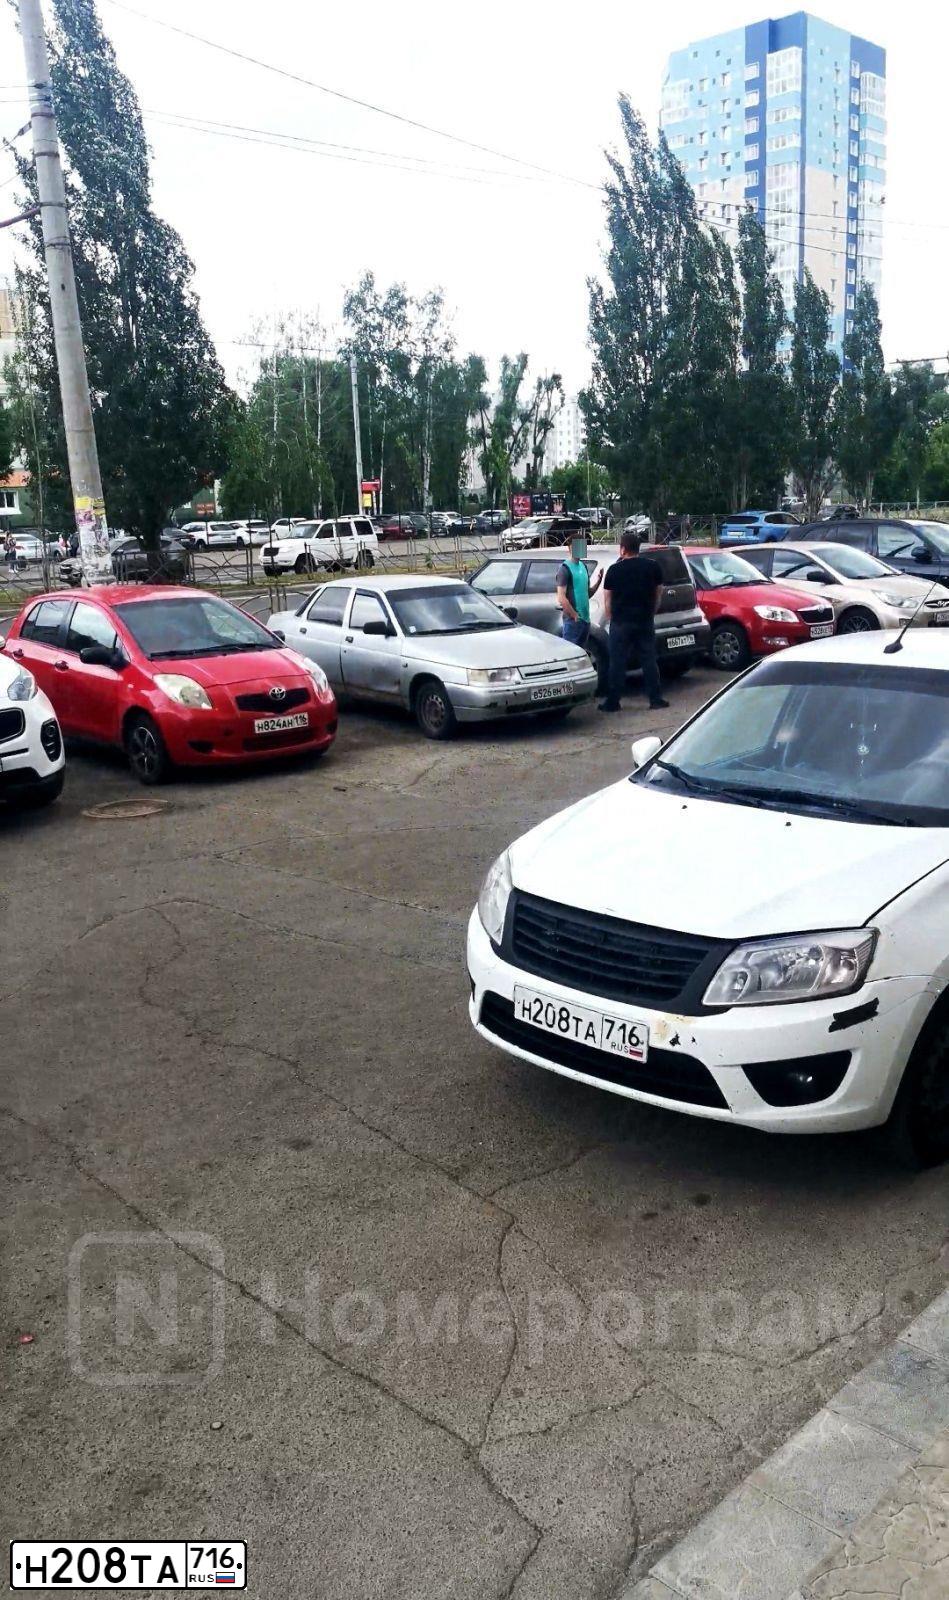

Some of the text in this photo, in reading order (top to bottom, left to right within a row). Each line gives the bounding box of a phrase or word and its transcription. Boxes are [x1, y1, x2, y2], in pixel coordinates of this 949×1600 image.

[522, 998, 640, 1047] Н208ТА 716
[611, 1041, 629, 1054] RUS
